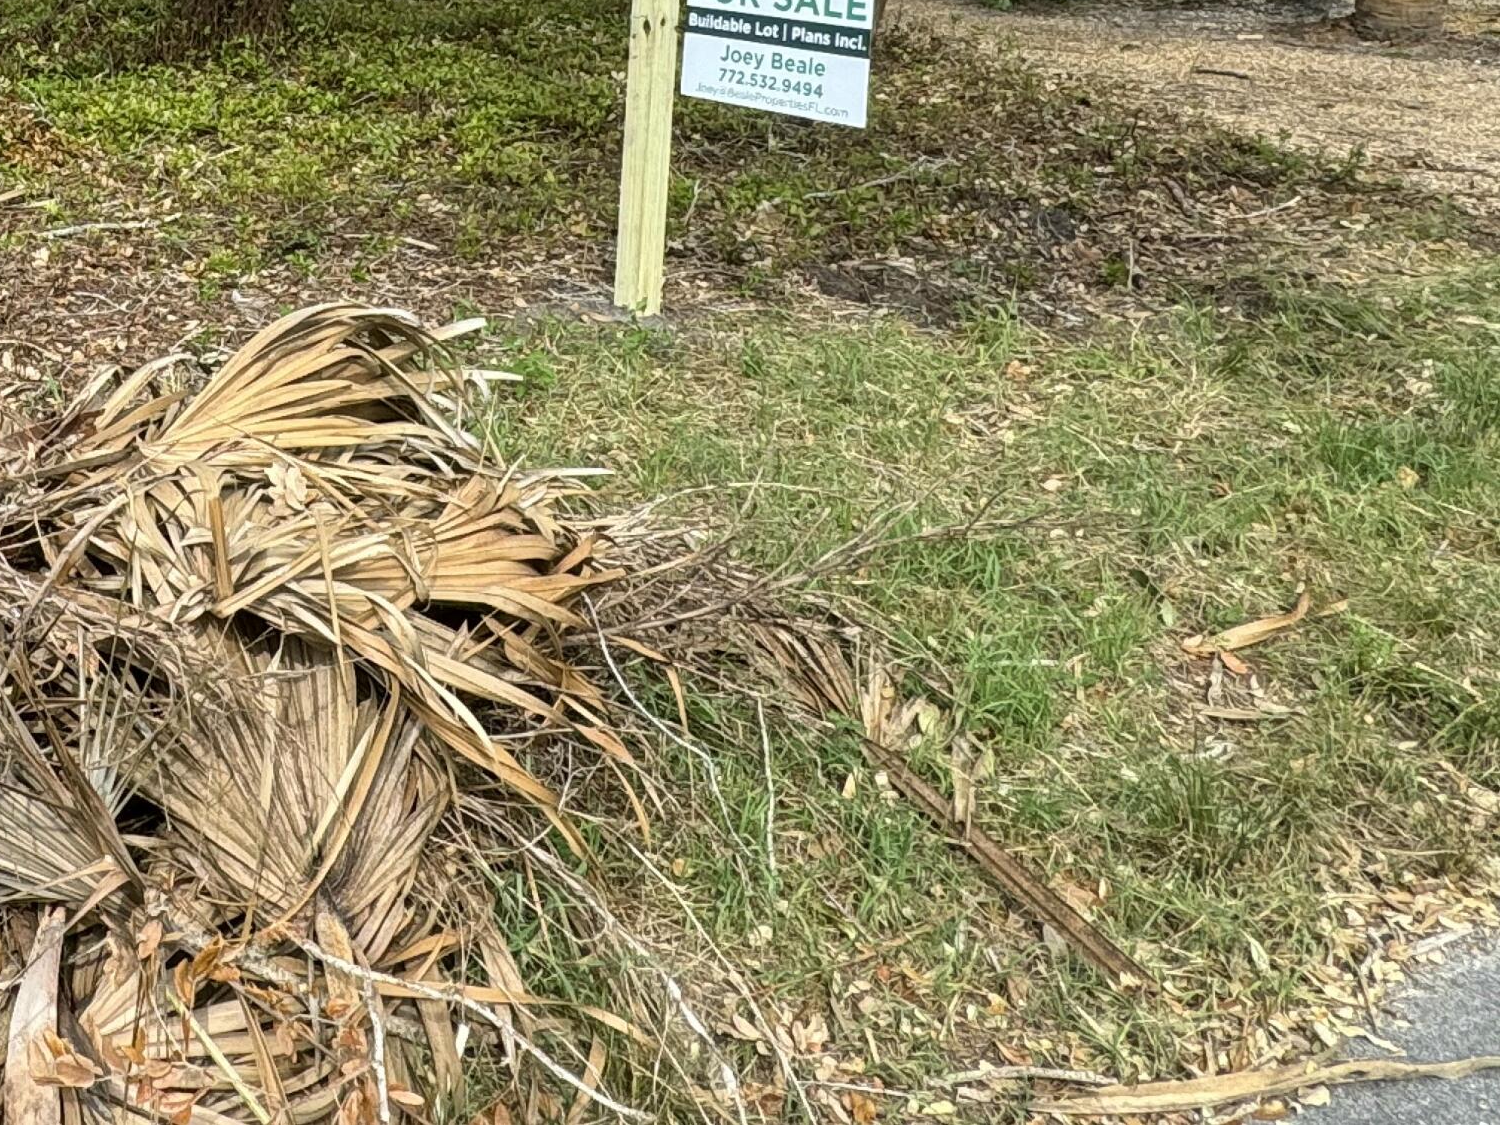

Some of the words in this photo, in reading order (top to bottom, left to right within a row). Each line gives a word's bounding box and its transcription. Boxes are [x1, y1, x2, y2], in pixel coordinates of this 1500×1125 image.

[688, 12, 751, 34] Buildable
[755, 21, 780, 38] Lot
[791, 26, 831, 46] Plans
[835, 32, 867, 51] Incl.
[720, 44, 764, 70] Joey
[771, 52, 826, 77] Beale
[718, 68, 824, 99] 772.532.9494
